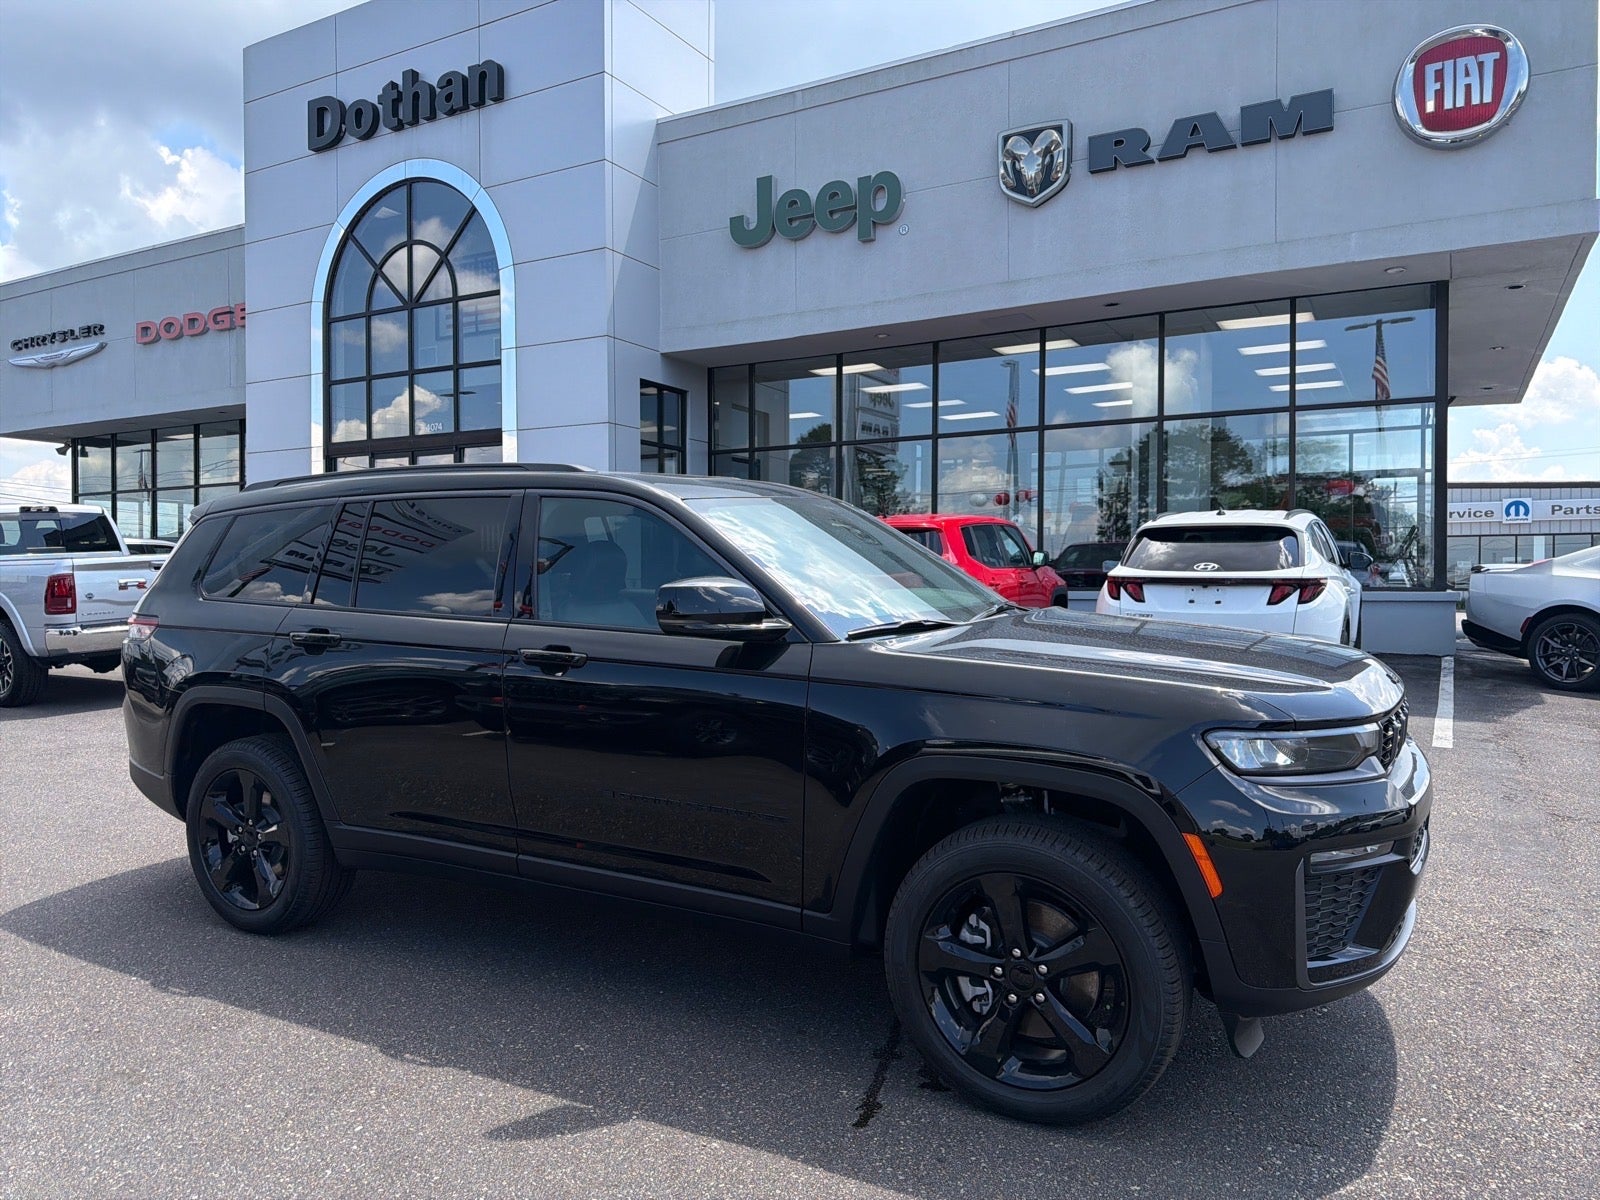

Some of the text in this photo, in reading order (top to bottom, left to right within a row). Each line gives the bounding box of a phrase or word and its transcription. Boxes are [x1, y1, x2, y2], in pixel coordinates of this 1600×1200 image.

[307, 59, 505, 152] Dothan
[1424, 51, 1500, 114] FIAT
[1087, 88, 1335, 175] RAM
[729, 170, 906, 249] Jeep
[10, 323, 105, 351] CHRYSLER
[425, 422, 443, 433] 4074
[1448, 507, 1495, 519] rvice
